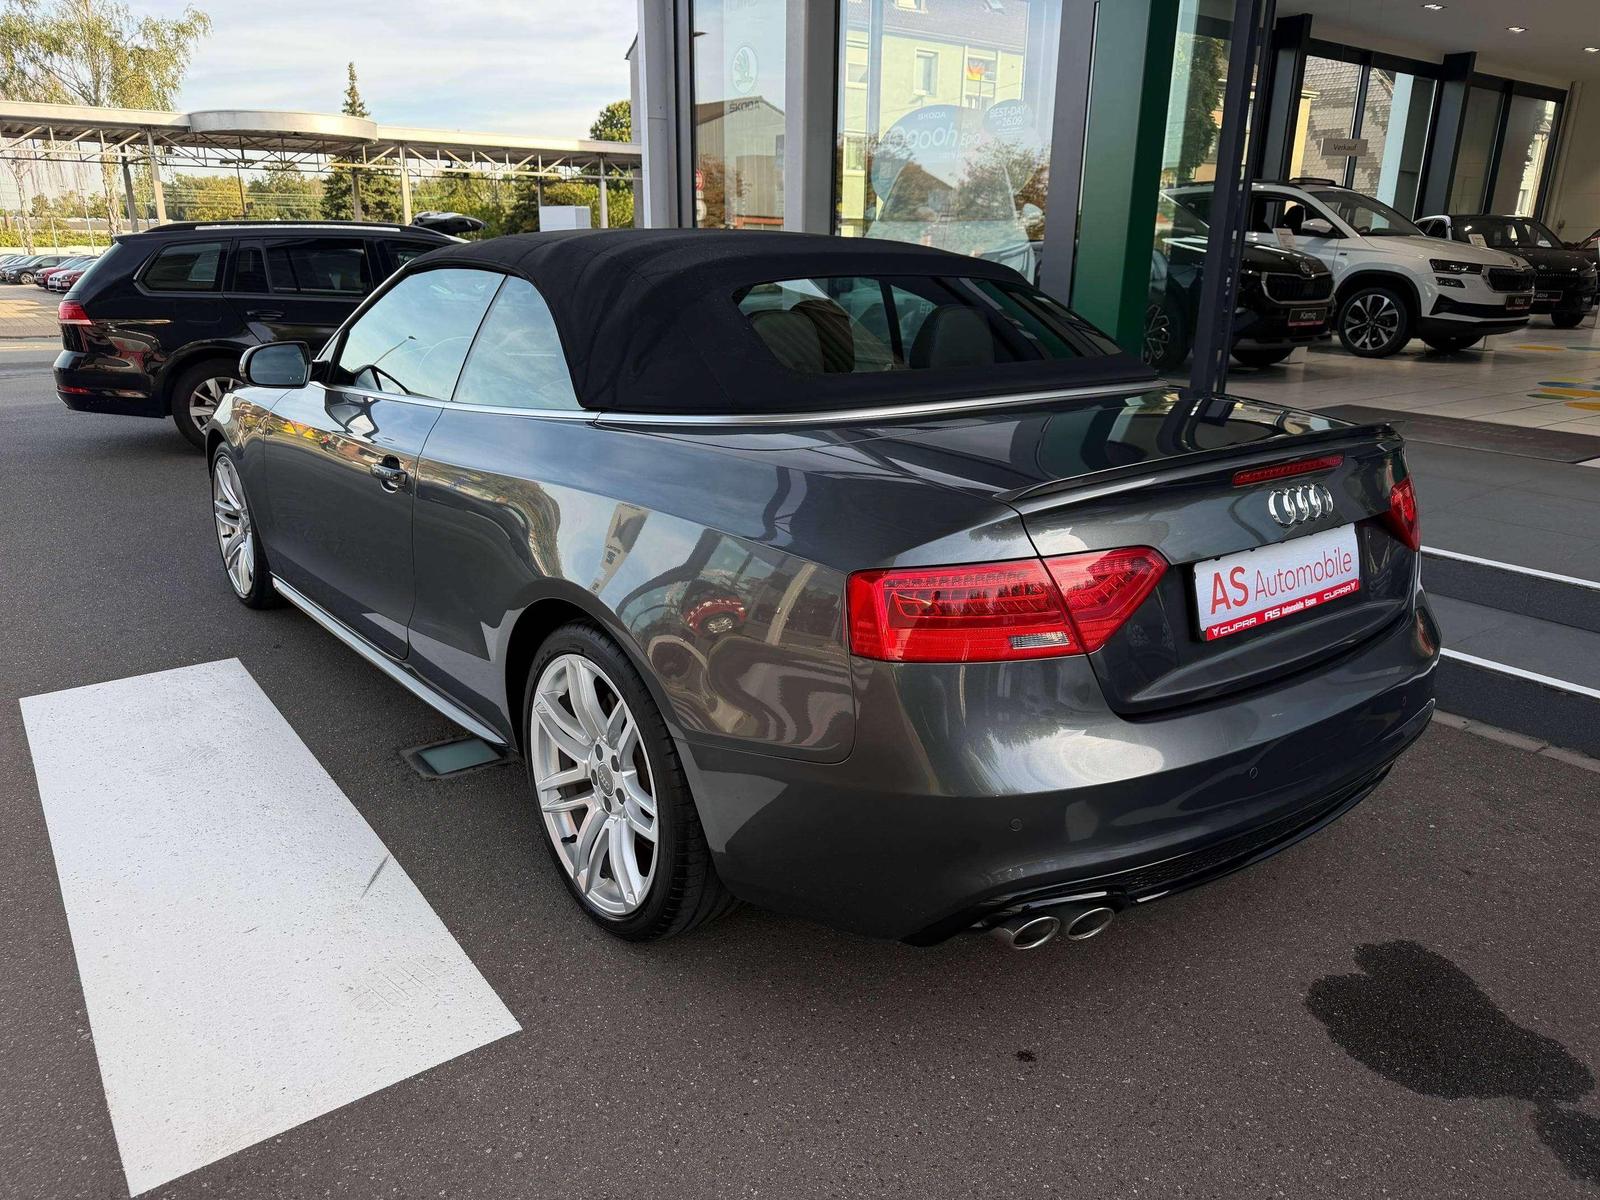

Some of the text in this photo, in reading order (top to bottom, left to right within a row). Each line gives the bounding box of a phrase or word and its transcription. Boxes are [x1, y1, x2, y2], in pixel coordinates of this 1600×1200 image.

[1333, 143, 1357, 151] Verkauf
[1211, 547, 1352, 614] AS Automobile
[1220, 617, 1257, 634] CUPRA
[1265, 608, 1281, 621] AS
[1323, 586, 1352, 600] CUPRA
